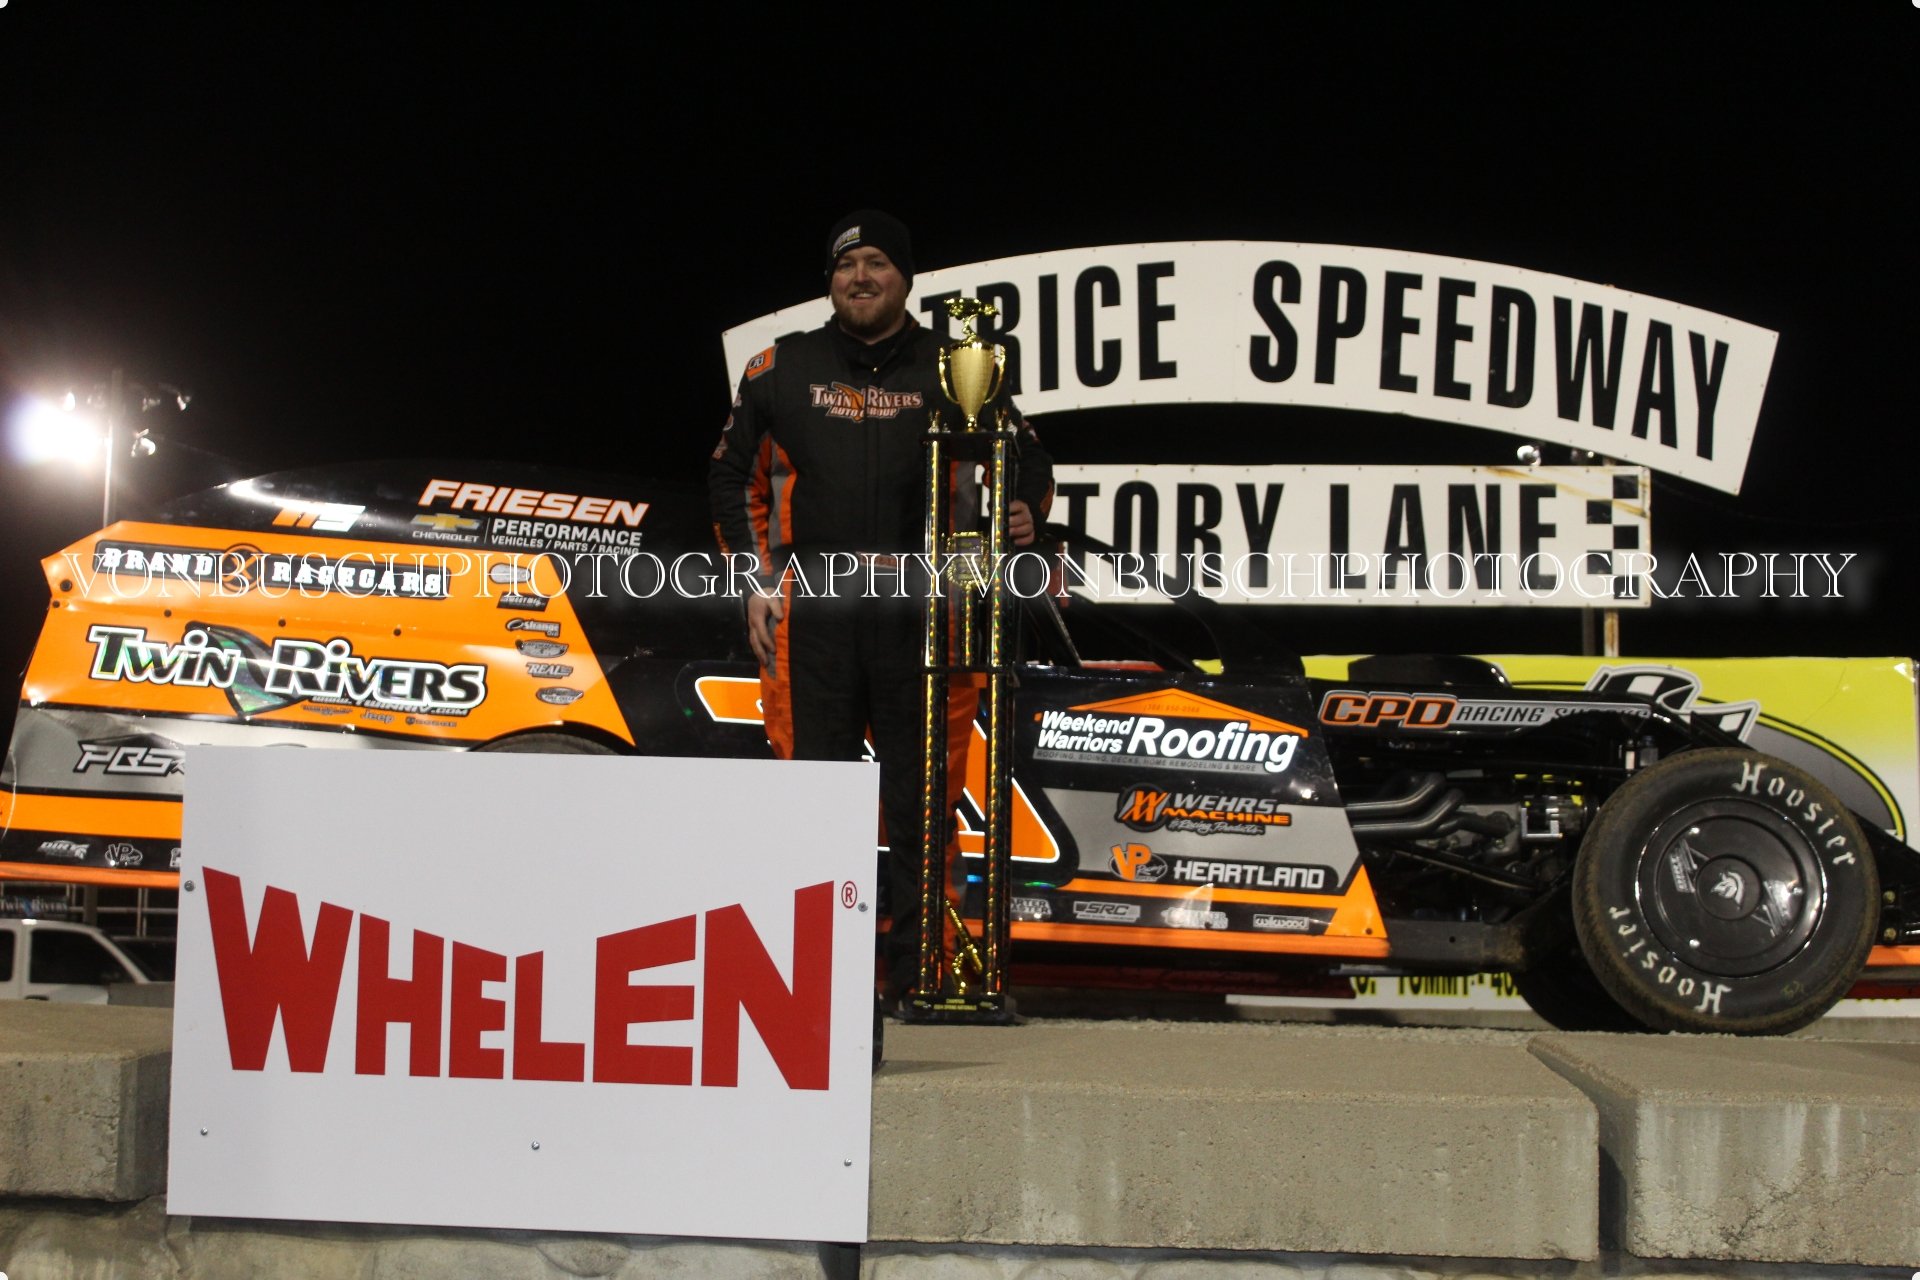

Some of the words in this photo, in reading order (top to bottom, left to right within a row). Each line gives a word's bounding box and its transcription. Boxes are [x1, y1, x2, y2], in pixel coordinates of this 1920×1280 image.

[921, 260, 1178, 396] TRICE
[1249, 260, 1730, 461] SPEEDWAY
[418, 478, 650, 528] FRIESEN
[412, 531, 480, 543] CHEVROLET
[491, 518, 643, 547] PERFORMANCE
[1057, 481, 1285, 590] TORY
[1328, 483, 1558, 591] LANE
[491, 535, 543, 548] VEHICLES
[553, 540, 588, 553] PARTS
[598, 544, 640, 557] RACING
[103, 547, 215, 577] BRAND
[271, 559, 443, 595] RACECARS
[529, 663, 561, 674] REAL
[360, 710, 394, 724] Jeep
[1041, 710, 1135, 735] Weekend
[1320, 691, 1458, 729] CPD
[1457, 705, 1545, 723] RACING
[1038, 729, 1123, 754] Warriors
[1127, 716, 1300, 773] Roofing
[1168, 759, 1223, 770] REMODELING
[1232, 763, 1257, 772] MORE
[1162, 808, 1290, 824] MACHINE
[1174, 793, 1277, 814] WEHRS
[1732, 760, 1856, 867] Hoosier
[1179, 819, 1211, 834] Racing
[1112, 843, 1152, 881] VP
[1174, 859, 1326, 890] HEARTLAND
[1011, 898, 1046, 907] RTER
[1012, 905, 1049, 913] ASTER
[1086, 902, 1130, 916] SRC
[1255, 914, 1308, 929] wilwood
[1609, 906, 1731, 1015] Hoosier
[202, 865, 834, 1091] WHELEN
